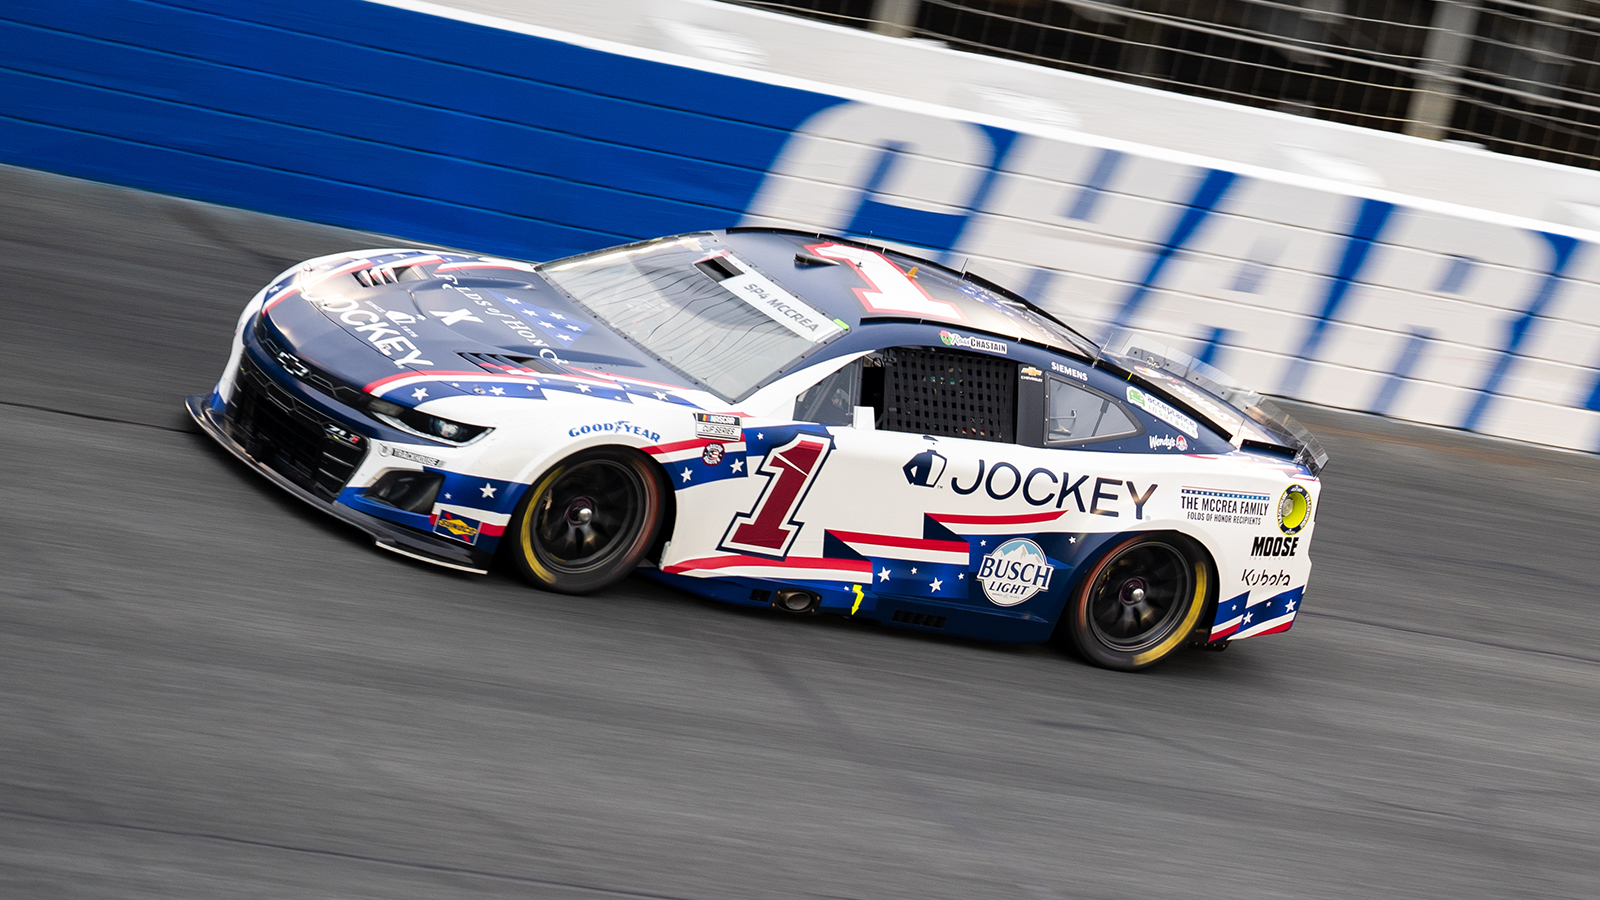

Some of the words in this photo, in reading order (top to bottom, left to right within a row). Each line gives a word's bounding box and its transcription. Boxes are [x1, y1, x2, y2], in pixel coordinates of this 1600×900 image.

[804, 241, 967, 321] 1
[485, 307, 515, 320] of
[743, 283, 768, 300] SP4
[767, 297, 819, 332] MCCREA
[300, 290, 434, 369] JOCKEY
[970, 338, 1006, 352] CHASTAIN
[1051, 361, 1088, 382] SIEMENS
[710, 414, 736, 425] NASCAR
[1147, 396, 1196, 428] acceptance
[1148, 404, 1196, 435] insurance
[702, 424, 715, 433] CUP
[715, 426, 736, 435] SERIES
[1149, 434, 1176, 450] Wendy's
[720, 433, 832, 558] 1
[950, 459, 1158, 520] JOCKEY
[1181, 496, 1198, 510] THE
[1201, 499, 1237, 514] MCCREA
[1240, 501, 1269, 516] FAMILY
[1187, 511, 1205, 521] FOLDS
[1205, 513, 1213, 522] OF
[1213, 514, 1232, 523] HONOR
[1233, 515, 1262, 526] RECIPIENTS
[1250, 537, 1299, 556] MOOSE
[980, 557, 1051, 587] BUSCH
[1241, 569, 1291, 586] Kubota
[989, 581, 1029, 595] LIGHT
